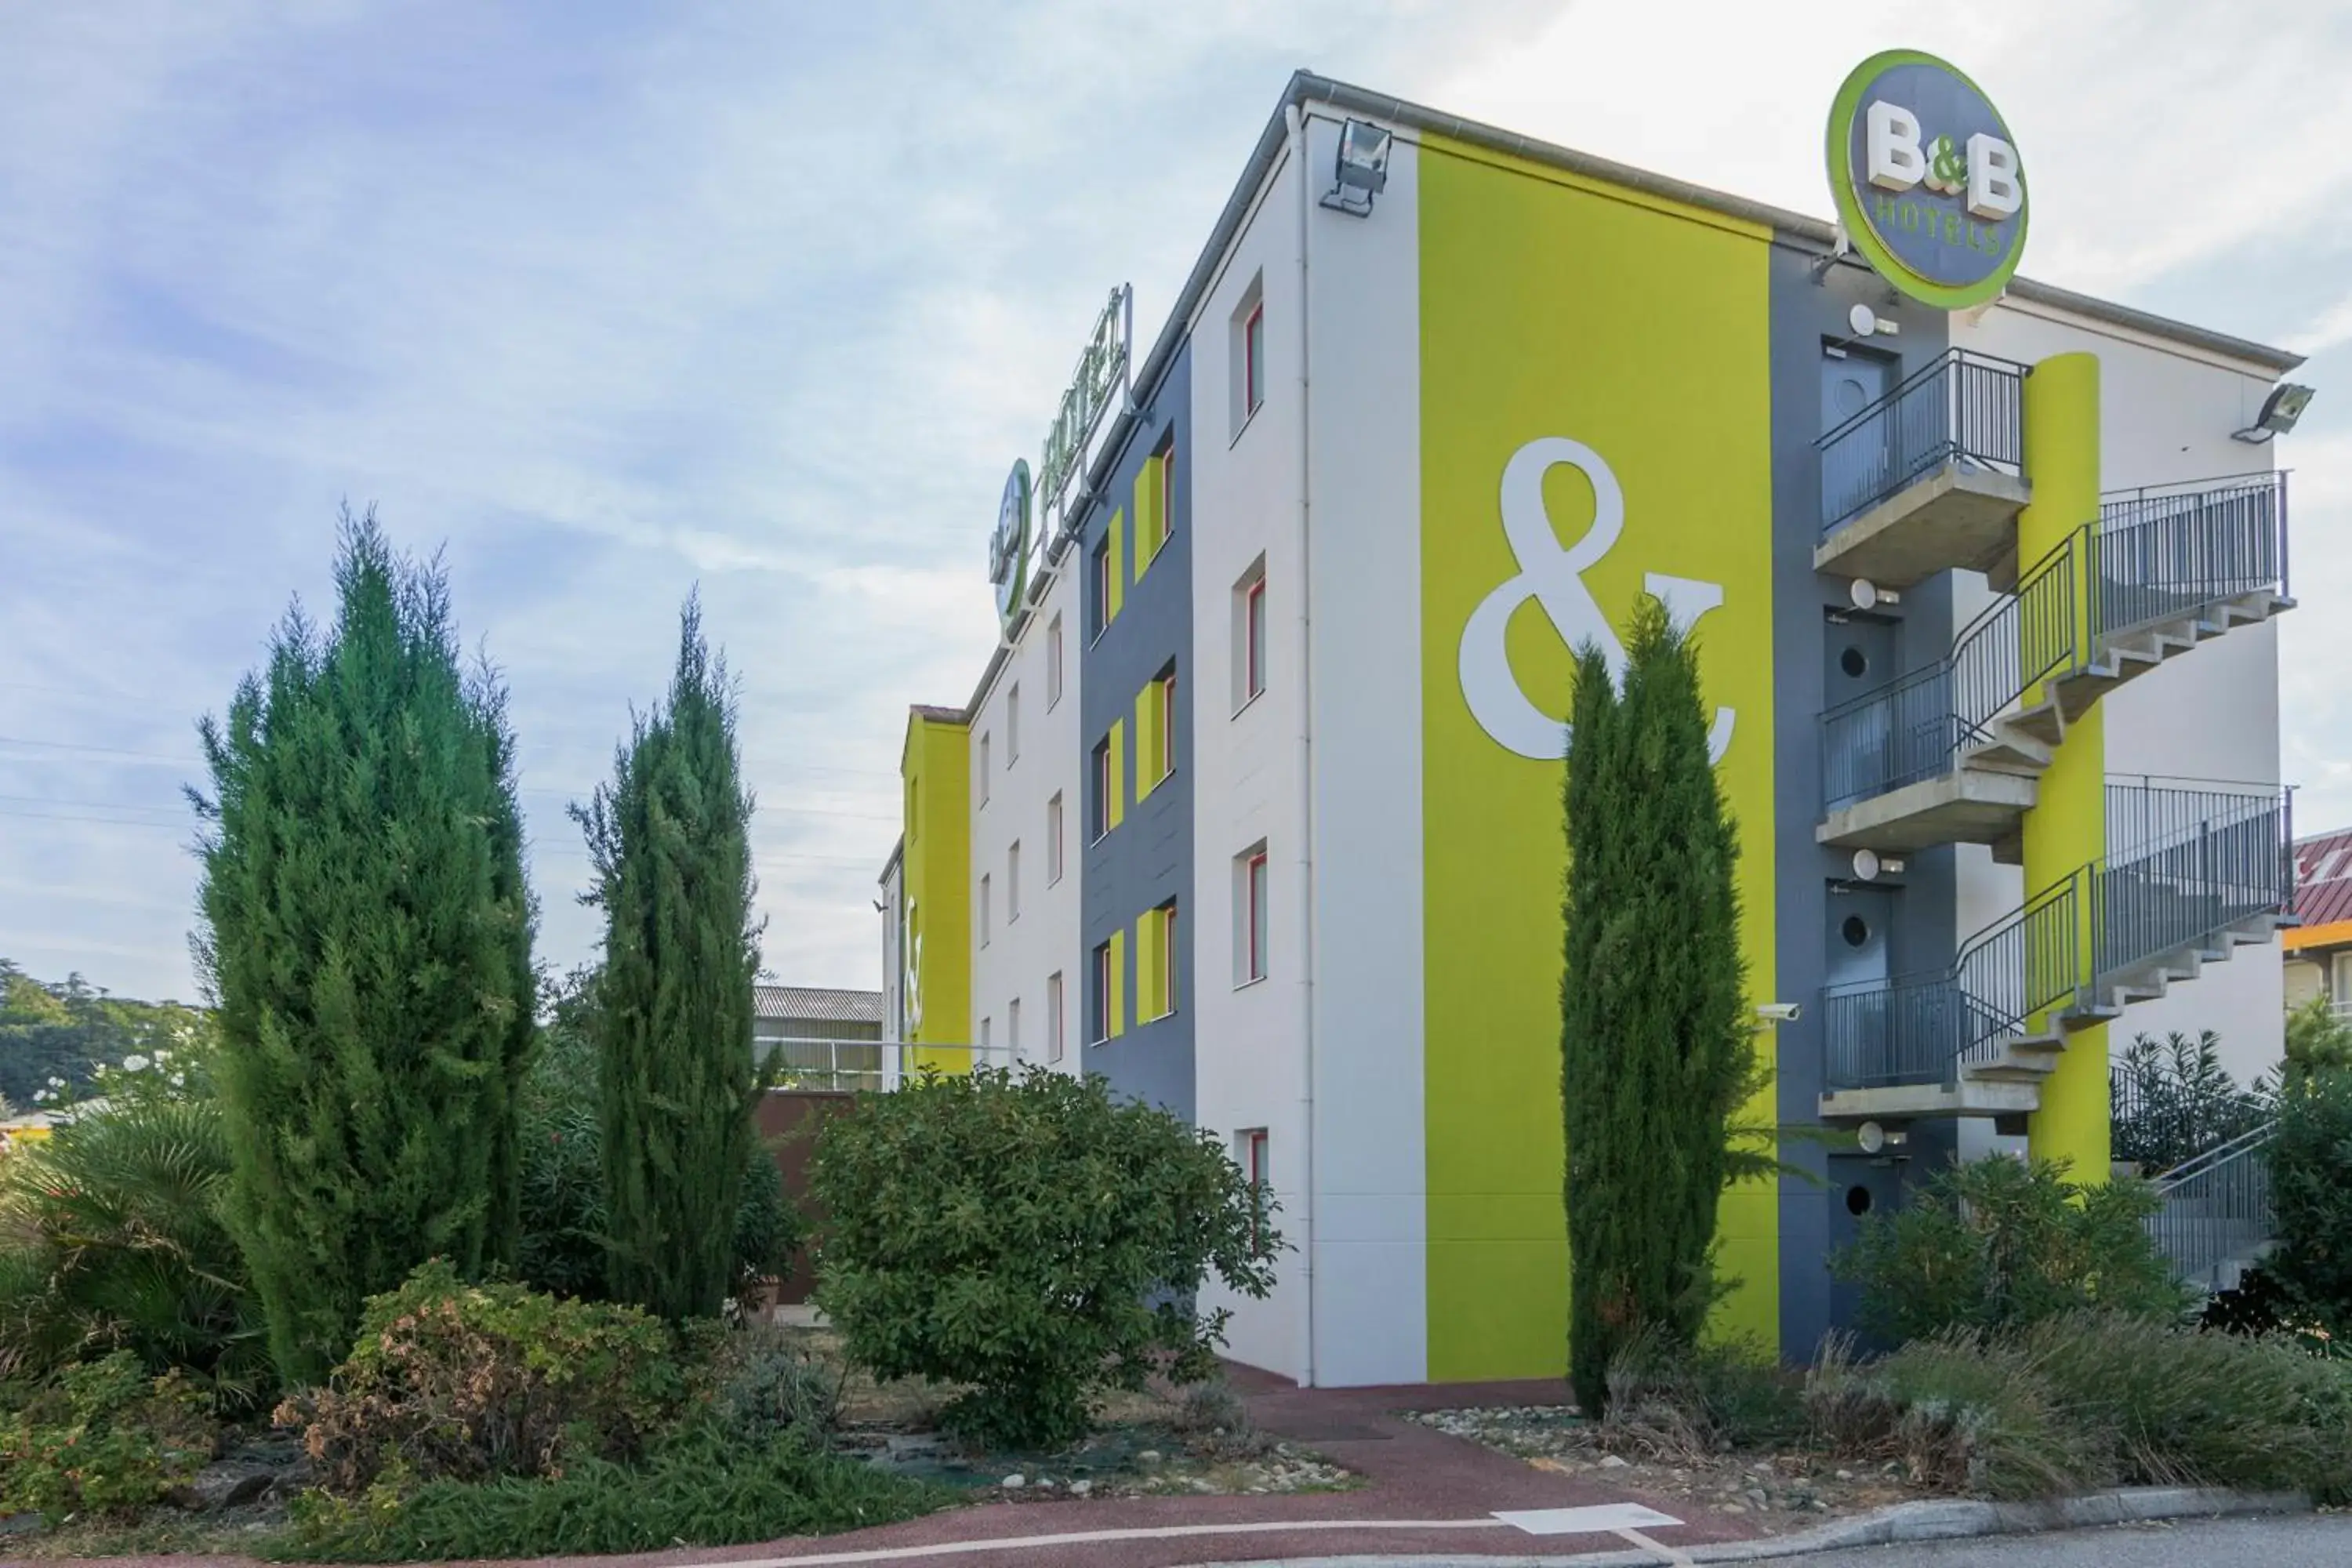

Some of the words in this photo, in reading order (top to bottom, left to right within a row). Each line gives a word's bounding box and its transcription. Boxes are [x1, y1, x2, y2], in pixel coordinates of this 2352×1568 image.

[1867, 100, 2023, 220] B&B
[1876, 195, 2000, 256] HOTELS
[1458, 436, 1736, 768] &
